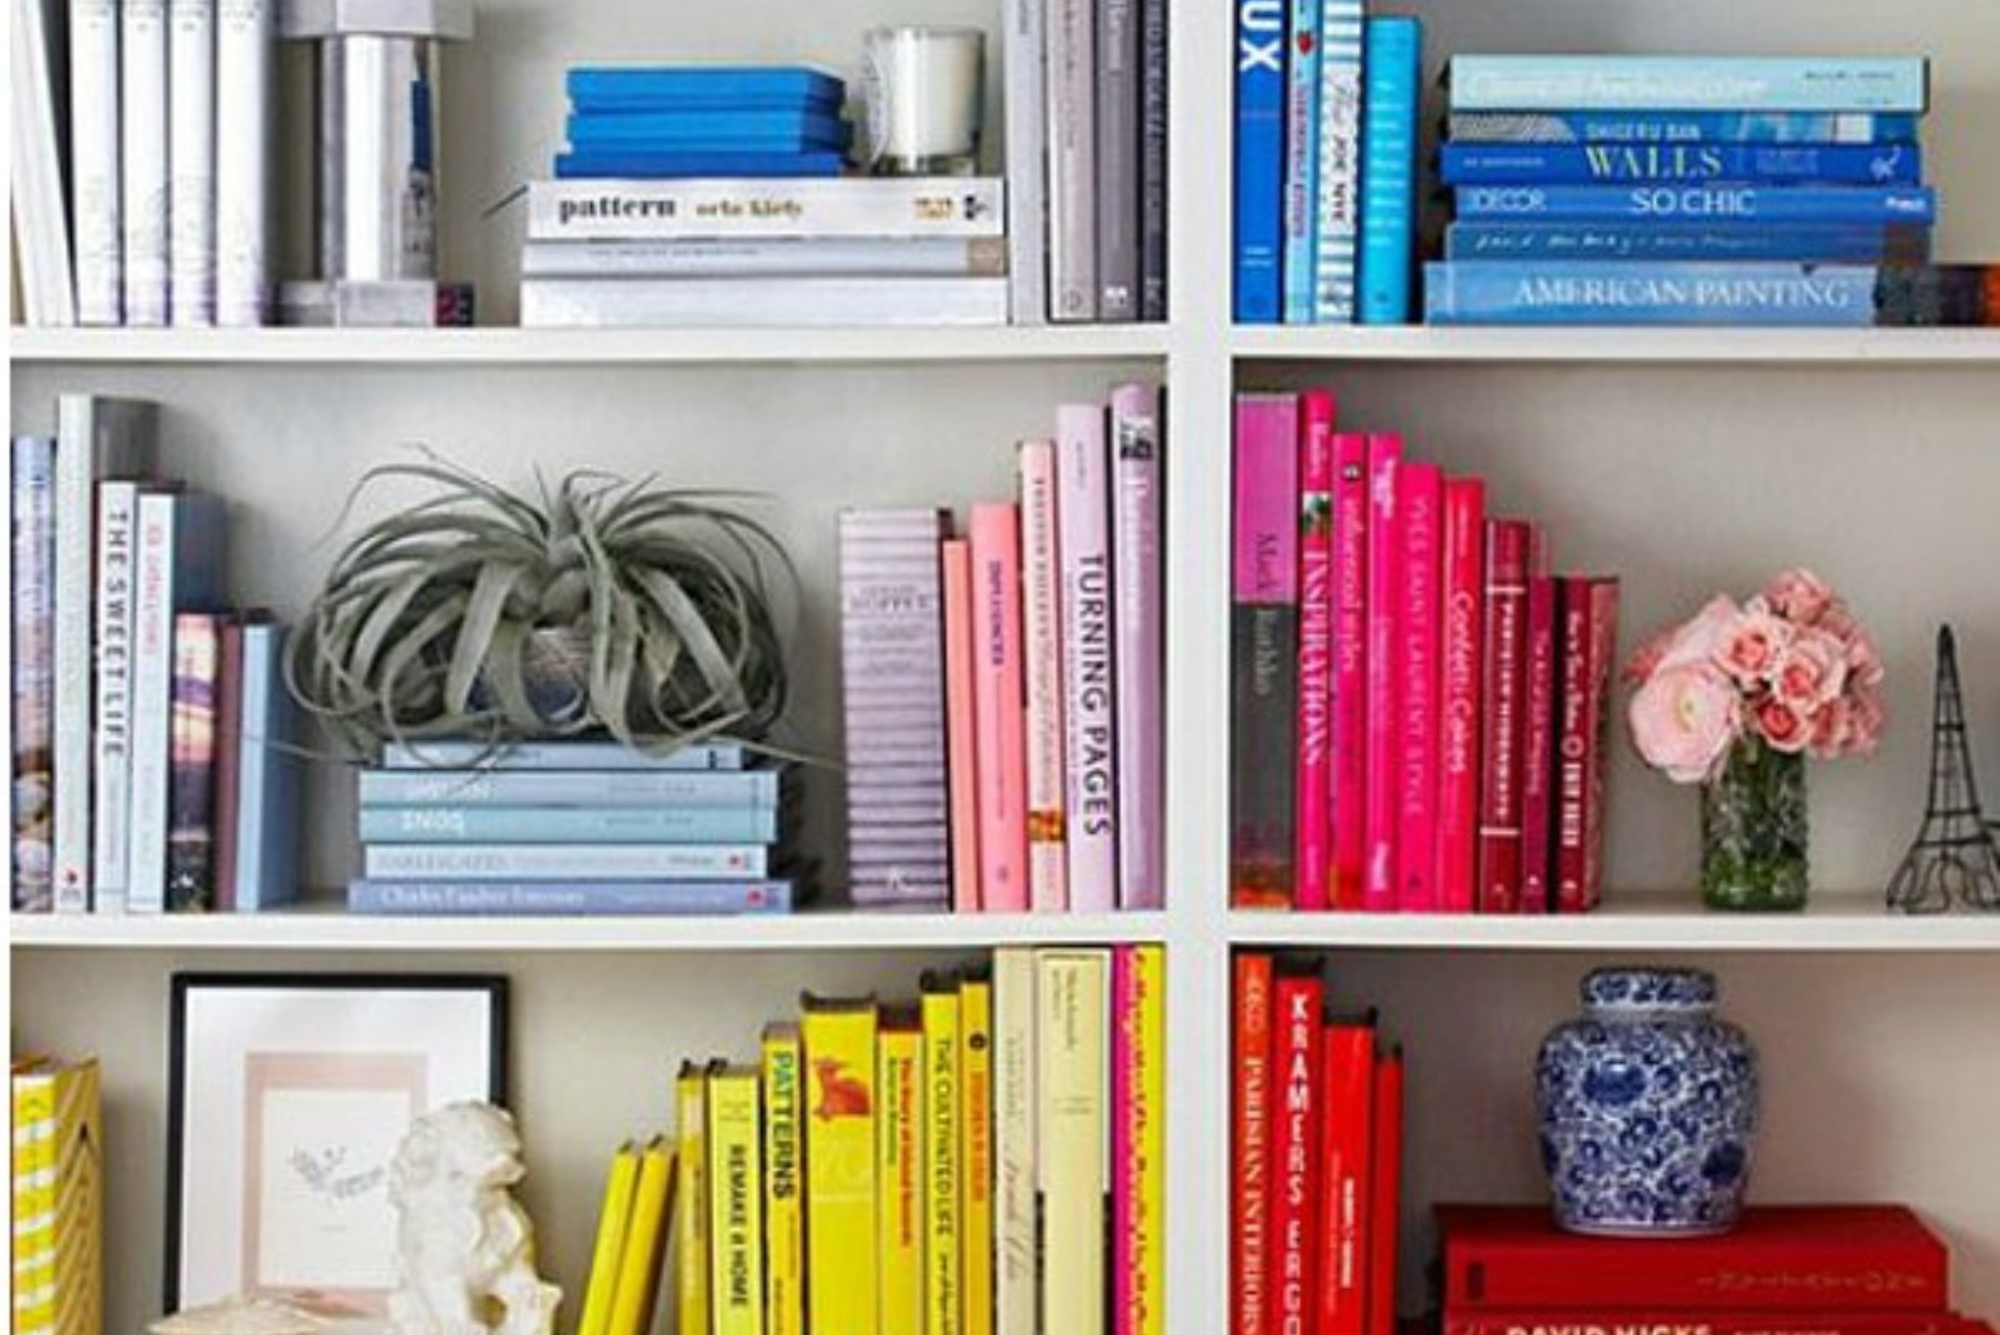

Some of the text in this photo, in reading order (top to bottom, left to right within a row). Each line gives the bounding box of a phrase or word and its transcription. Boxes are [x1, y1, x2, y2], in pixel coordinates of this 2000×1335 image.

[1585, 146, 1721, 180] WALLS
[560, 196, 676, 225] pattern
[1681, 187, 1756, 214] CHIC
[1515, 276, 1851, 309] AMERICAN PAINTING
[104, 509, 128, 758] THE SWEET LIFE
[1079, 553, 1111, 836] TURNING PAGES
[772, 1050, 797, 1201] PATTERNS
